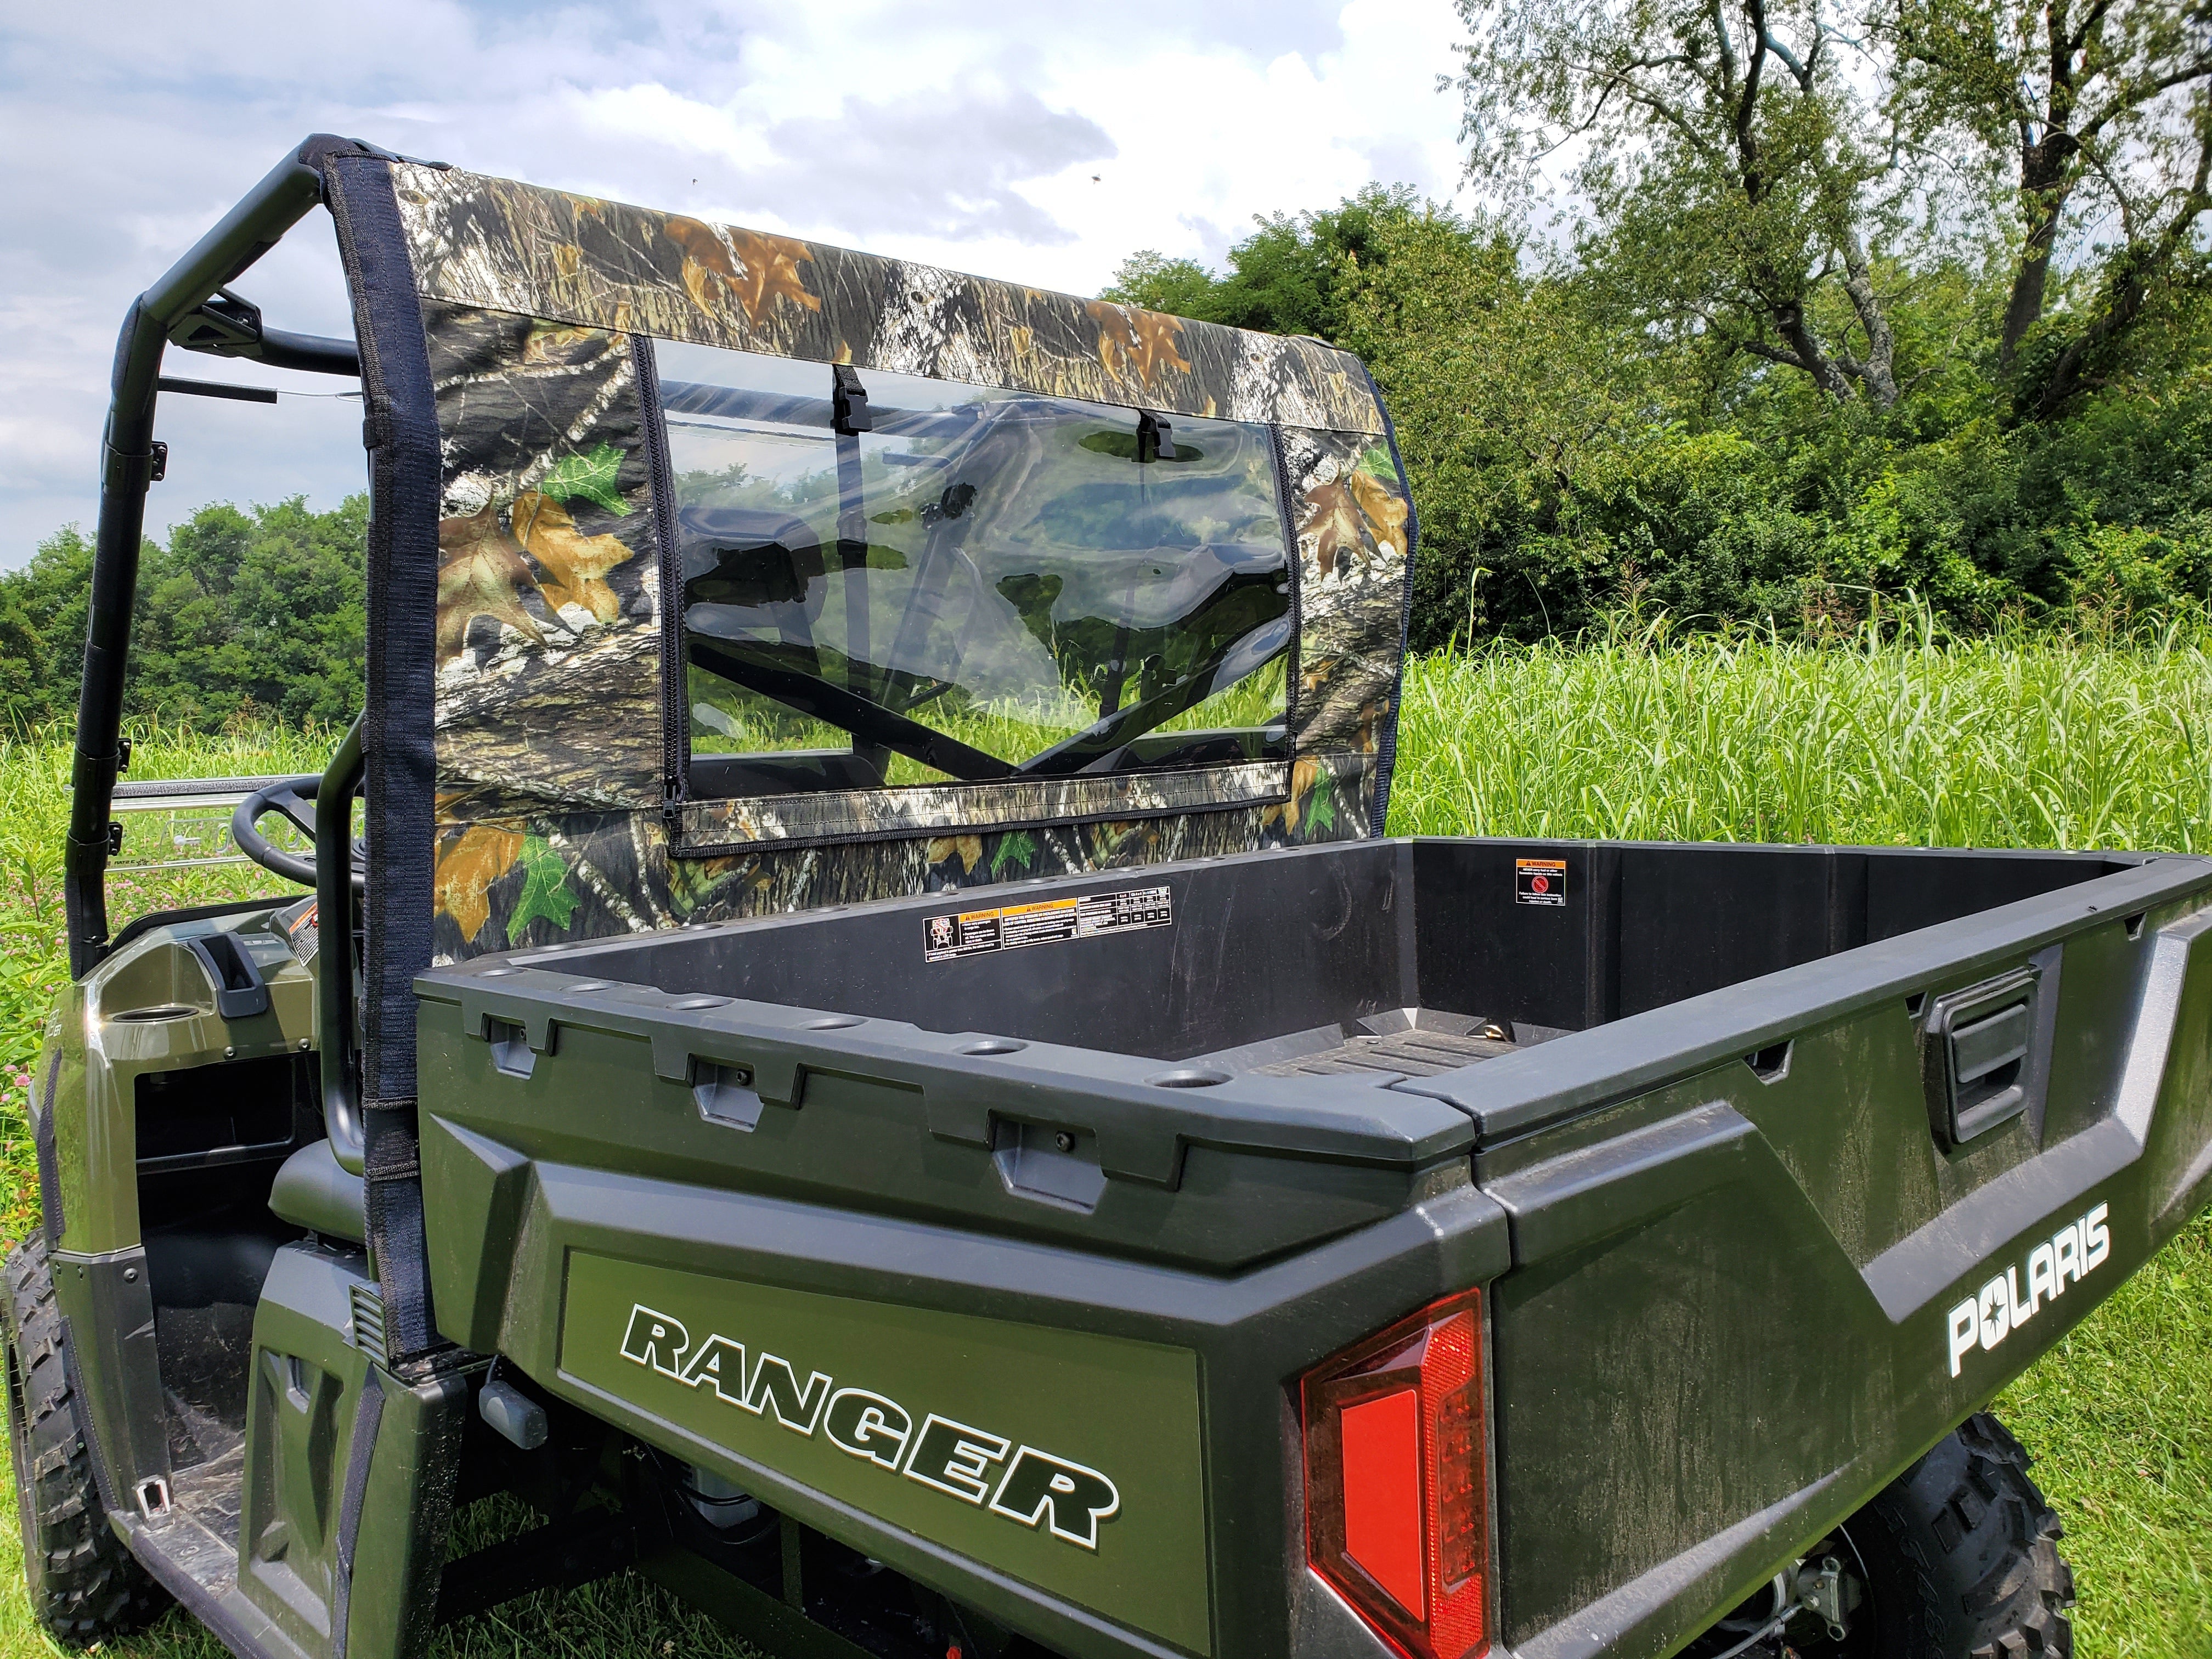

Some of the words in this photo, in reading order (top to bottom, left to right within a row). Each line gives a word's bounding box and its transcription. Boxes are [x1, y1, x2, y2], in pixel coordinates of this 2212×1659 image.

[970, 911, 994, 919] WARNING
[1948, 1201, 2109, 1378] POLARIS
[620, 1303, 1120, 1549] RANGER
